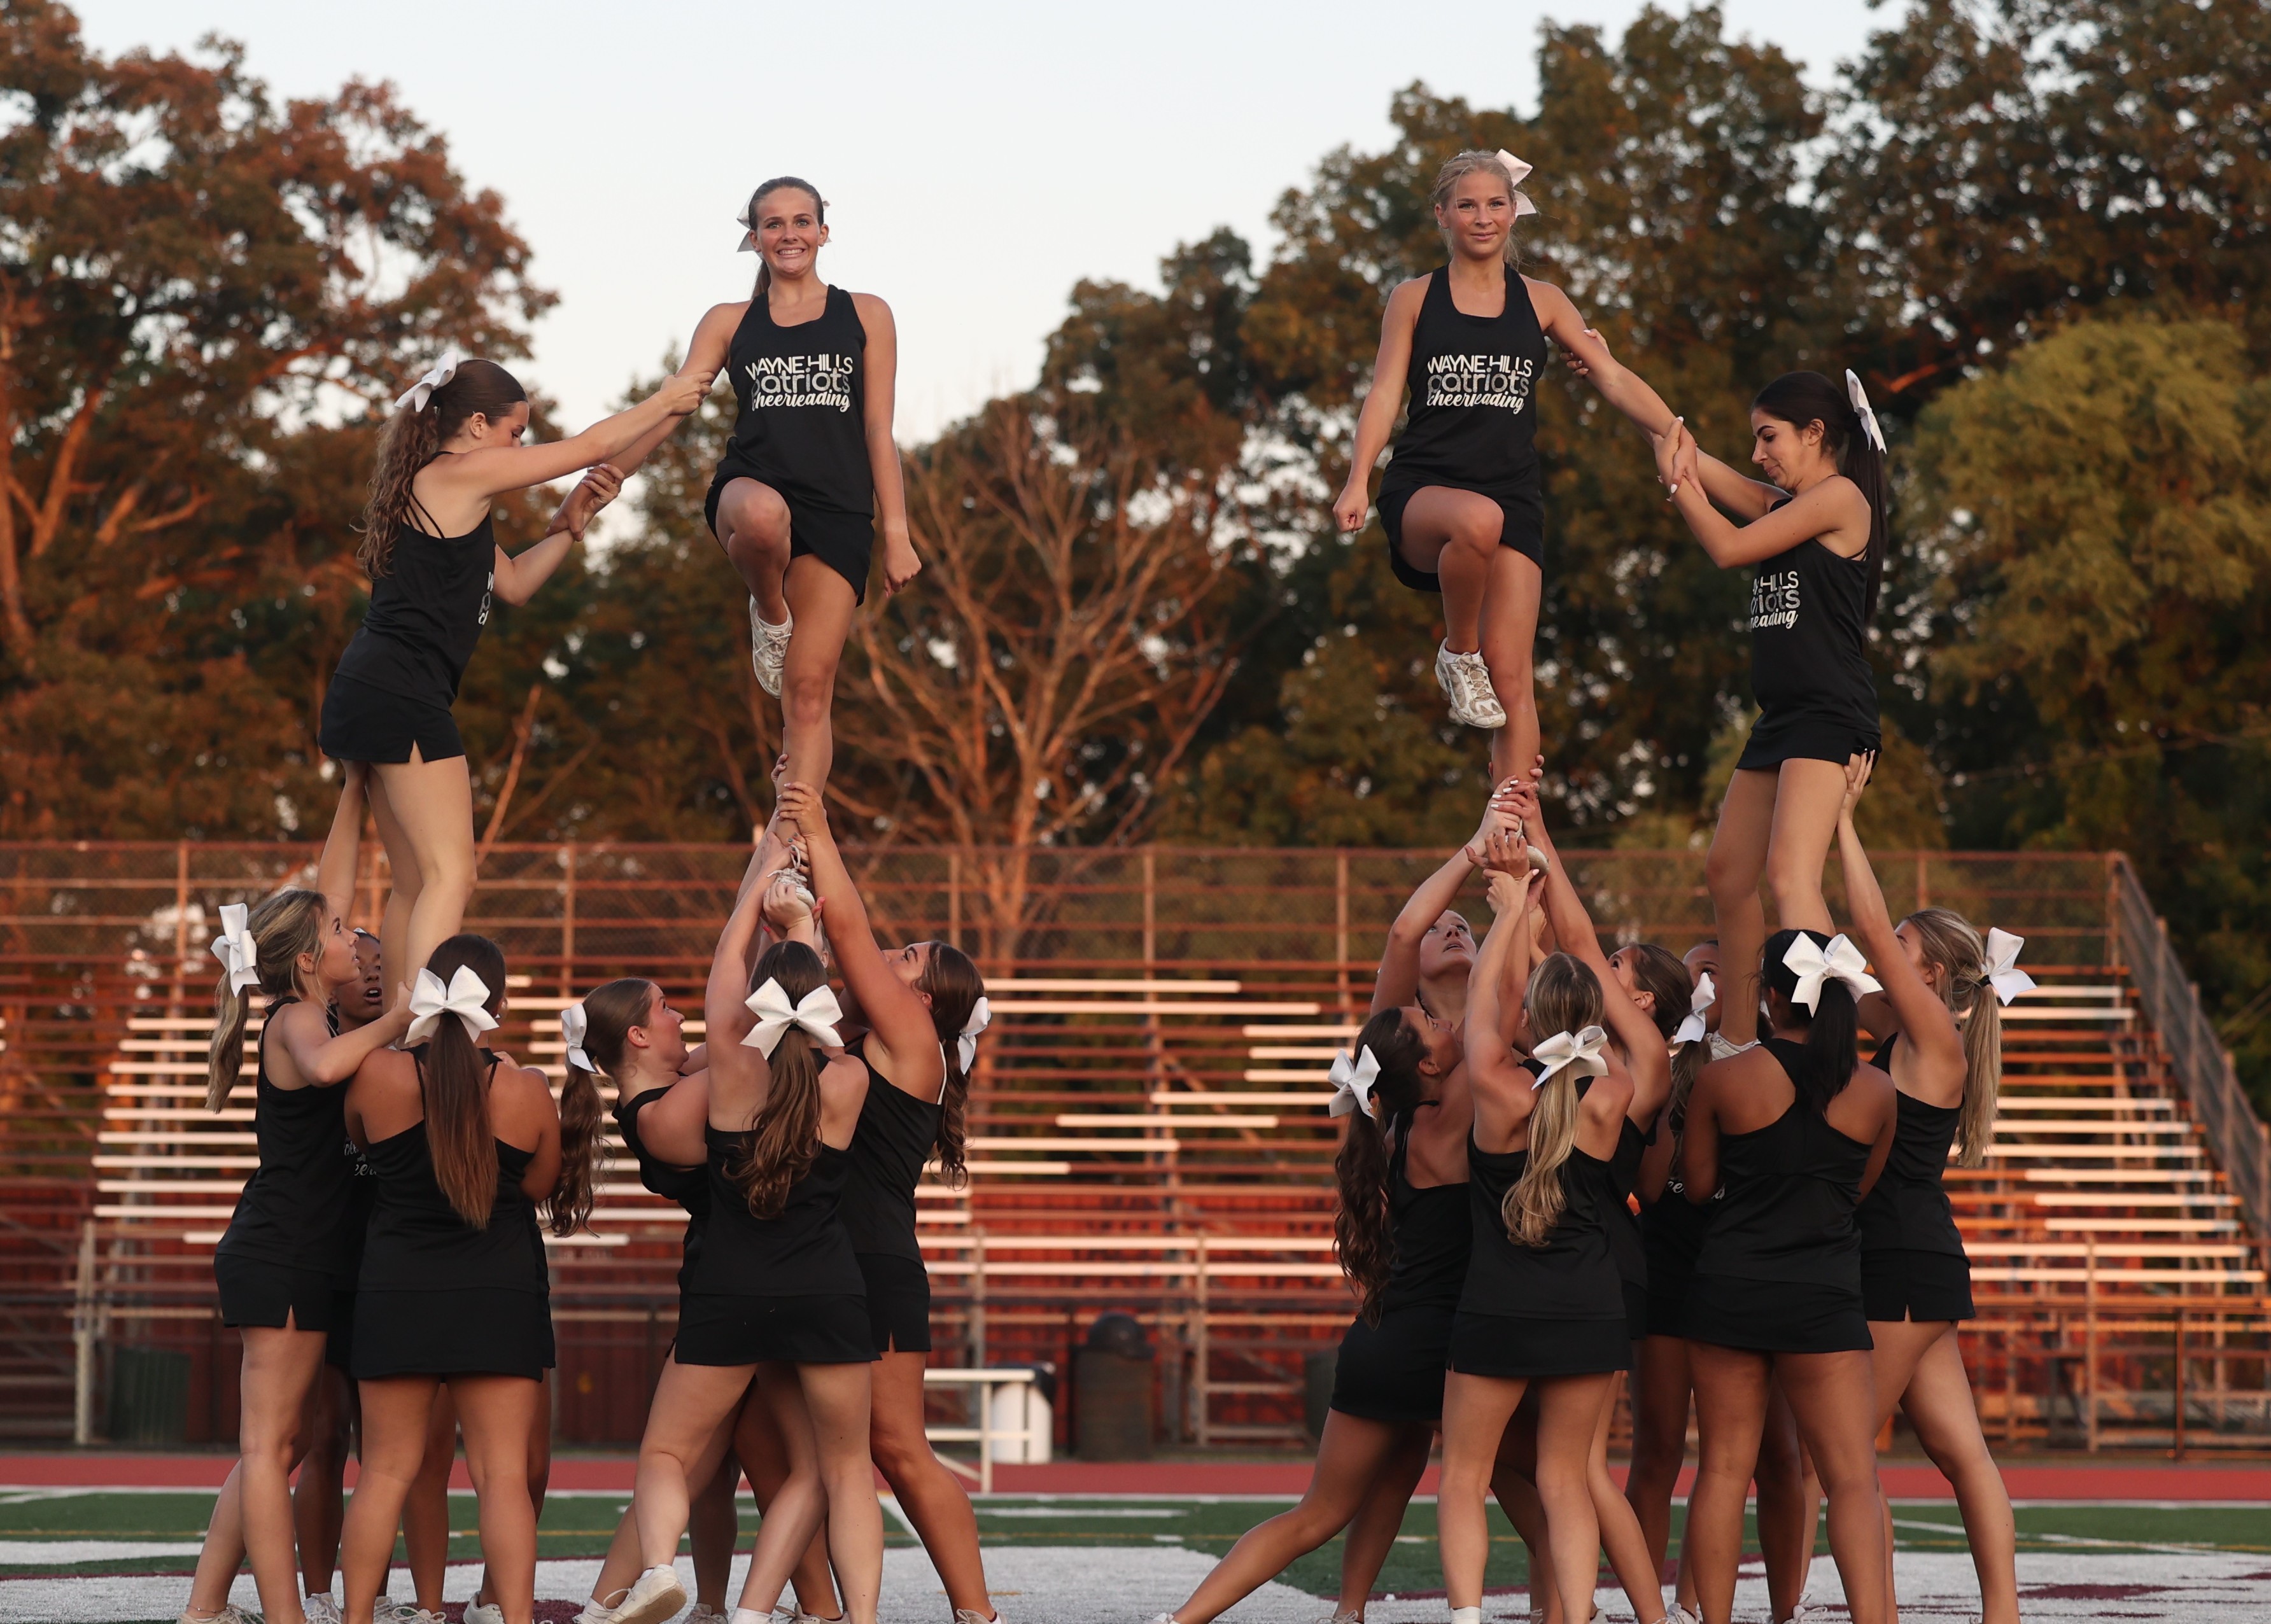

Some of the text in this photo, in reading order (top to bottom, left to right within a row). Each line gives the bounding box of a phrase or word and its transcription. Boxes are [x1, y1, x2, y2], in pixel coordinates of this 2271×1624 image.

[745, 354, 853, 380] WAYNE HILLS
[1427, 354, 1533, 377] WAYNE HILLS
[1428, 367, 1529, 400] patriots
[1426, 390, 1524, 414] cheerleading
